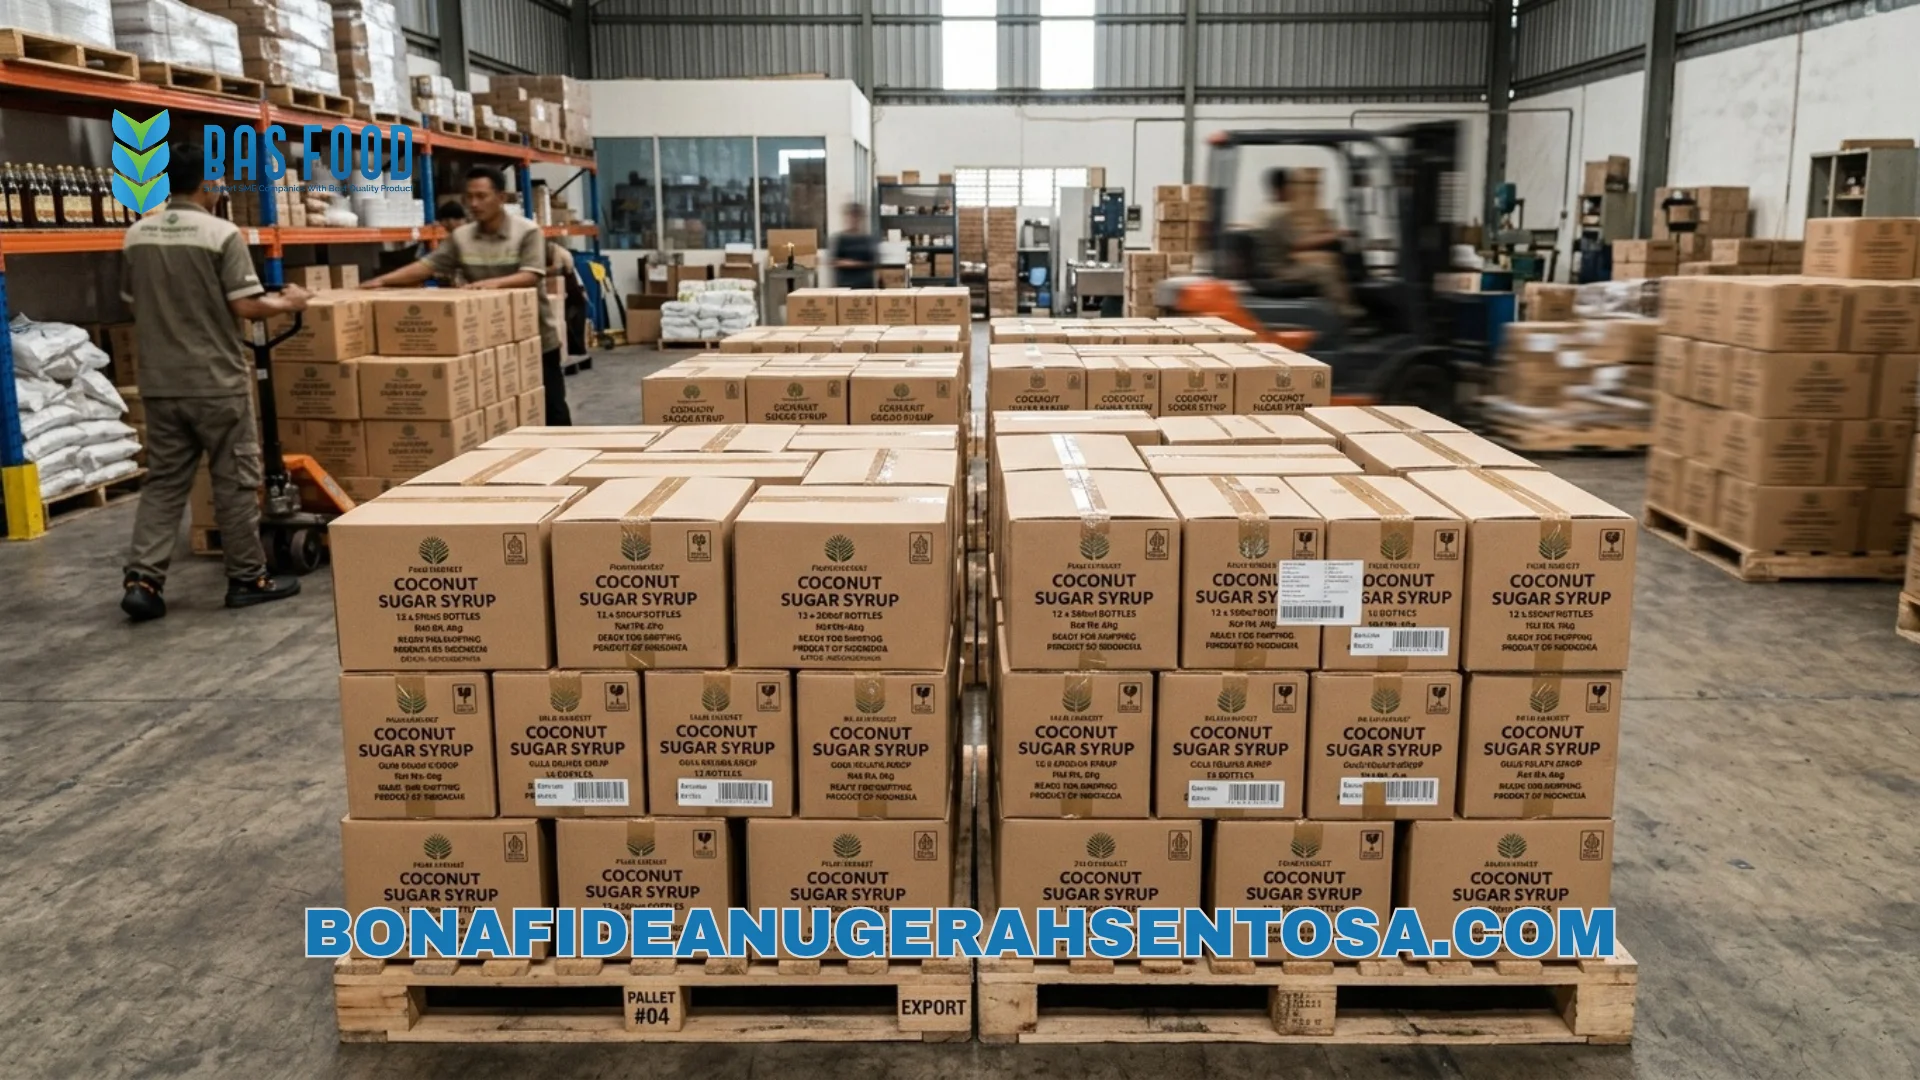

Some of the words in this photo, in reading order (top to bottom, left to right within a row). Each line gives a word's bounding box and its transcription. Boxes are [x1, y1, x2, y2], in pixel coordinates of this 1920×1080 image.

[394, 577, 478, 591] COCONUT
[596, 575, 679, 588] COCONUT
[798, 576, 882, 589] COCONUT
[1053, 574, 1136, 587] COCONUT
[1363, 574, 1434, 587] OCONUT
[1510, 574, 1595, 588] COCONUT
[379, 594, 437, 608] SUGAR
[441, 594, 496, 608] SYRUP
[580, 592, 637, 605] SUGAR
[642, 592, 697, 605] SYRUP
[781, 593, 839, 606] SUGAR
[843, 594, 899, 607] SYRUP
[1035, 591, 1093, 605] SUGAR
[1098, 591, 1153, 605] SYRUP
[1196, 590, 1253, 603] SUGAR
[1397, 591, 1452, 604] SYRUP
[1492, 592, 1550, 605] SUGAR
[1555, 592, 1611, 605] SYRUP
[374, 727, 455, 740] COCONUT
[526, 726, 607, 739] COCONUT
[676, 725, 757, 738] COCONUT
[830, 727, 912, 740] COCONUT
[1035, 726, 1117, 738] COCONUT
[1190, 726, 1272, 739] COCONUT
[1344, 727, 1425, 740] COCONUT
[1502, 726, 1584, 739] COCONUT
[359, 744, 415, 757] SUGAR
[419, 744, 473, 757] SYRUP
[510, 742, 567, 755] SUGAR
[571, 742, 625, 755] SYRUP
[660, 741, 716, 754] SUGAR
[721, 741, 775, 754] SYRUP
[813, 743, 870, 756] SUGAR
[874, 744, 929, 756] SYRUP
[1019, 742, 1076, 755] SUGAR
[1080, 743, 1134, 755] SYRUP
[1173, 743, 1230, 756] SUGAR
[1234, 743, 1288, 756] SYRUP
[1326, 744, 1383, 757] SUGAR
[1387, 744, 1442, 757] SYRUP
[1484, 742, 1541, 755] SUGAR
[1545, 743, 1601, 755] SYRUP
[400, 873, 480, 885] COCONUT
[602, 869, 682, 882] COCONUT
[807, 872, 888, 884] COCONUT
[1060, 872, 1142, 884] COCONUT
[1263, 872, 1346, 884] COCONUT
[1471, 872, 1552, 885] COCONUT
[384, 888, 440, 901] SUGAR
[445, 889, 498, 901] SYRUP
[586, 886, 642, 898] SUGAR
[646, 886, 700, 898] SYRUP
[790, 888, 847, 900] SUGAR
[852, 888, 906, 901] SYRUP
[1043, 887, 1099, 900] SUGAR
[1104, 888, 1158, 900] SYRUP
[1248, 887, 1302, 900] SUGAR
[1307, 888, 1362, 900] SYRUP
[1452, 888, 1510, 901] SUGAR
[1515, 888, 1569, 901] SYRUP
[628, 992, 675, 1004] PALLET
[902, 999, 966, 1015] EXPORT
[634, 1007, 670, 1025] #04
